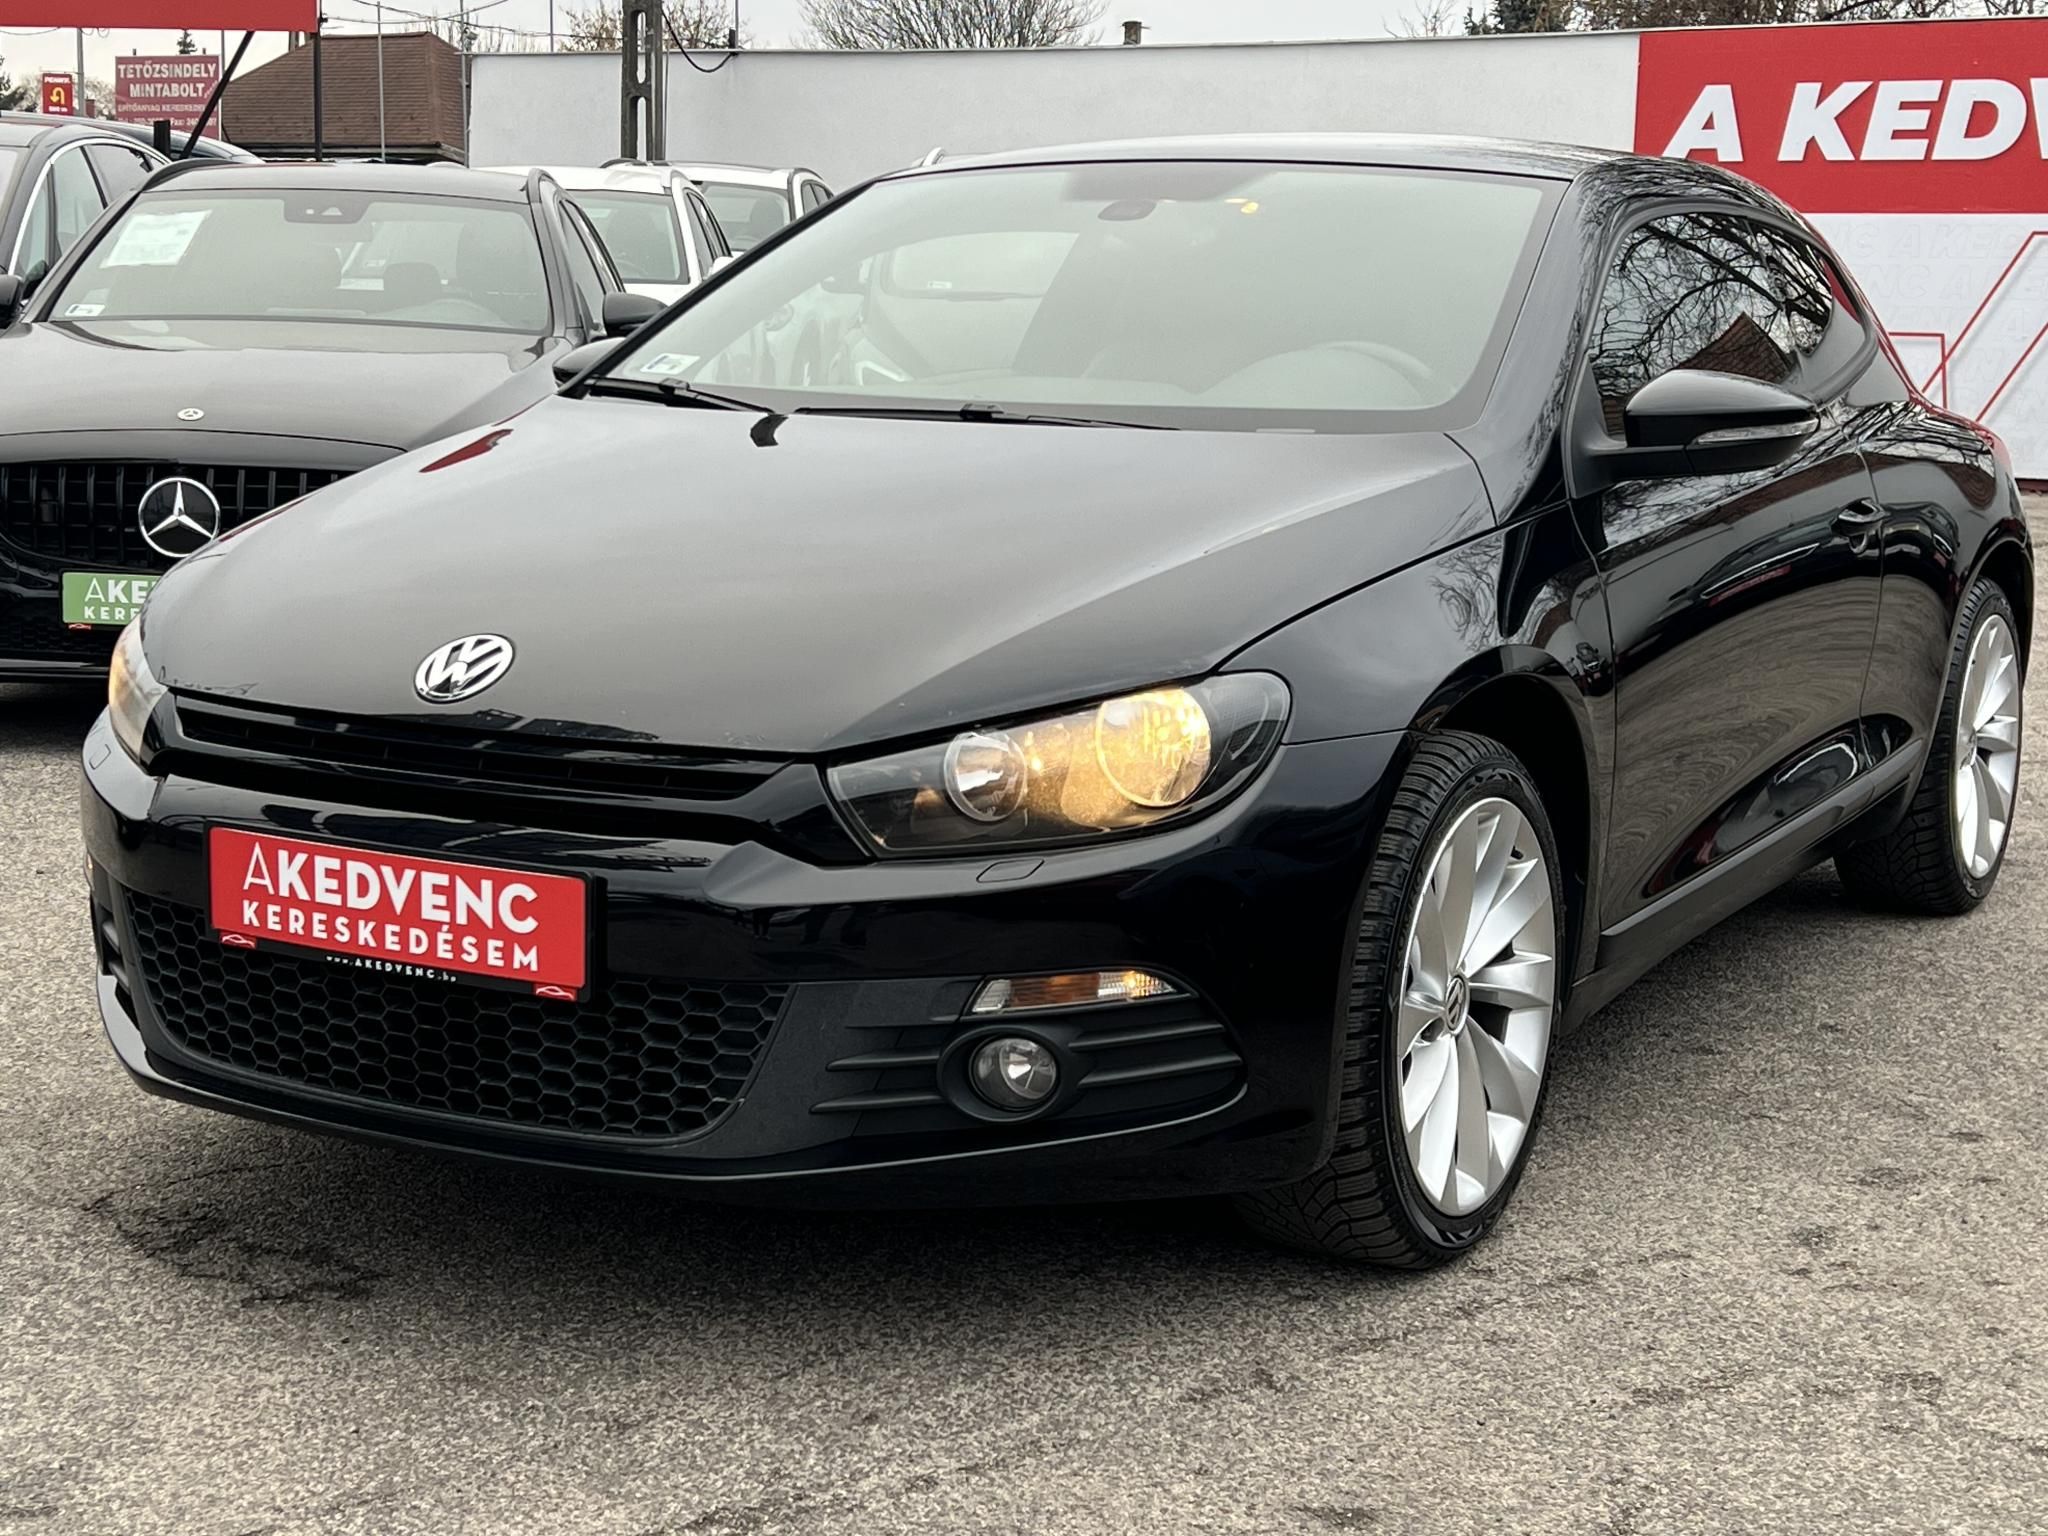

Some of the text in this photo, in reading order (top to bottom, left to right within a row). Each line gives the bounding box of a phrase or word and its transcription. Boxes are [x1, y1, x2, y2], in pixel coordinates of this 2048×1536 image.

[118, 60, 217, 79] TETŐZSINDELY
[129, 83, 206, 98] MINTABOLT
[1661, 78, 2048, 162] A KED
[84, 577, 158, 604] AKE
[243, 841, 539, 934] AKEDVENC
[242, 900, 539, 972] KERESKEDÉSEM
